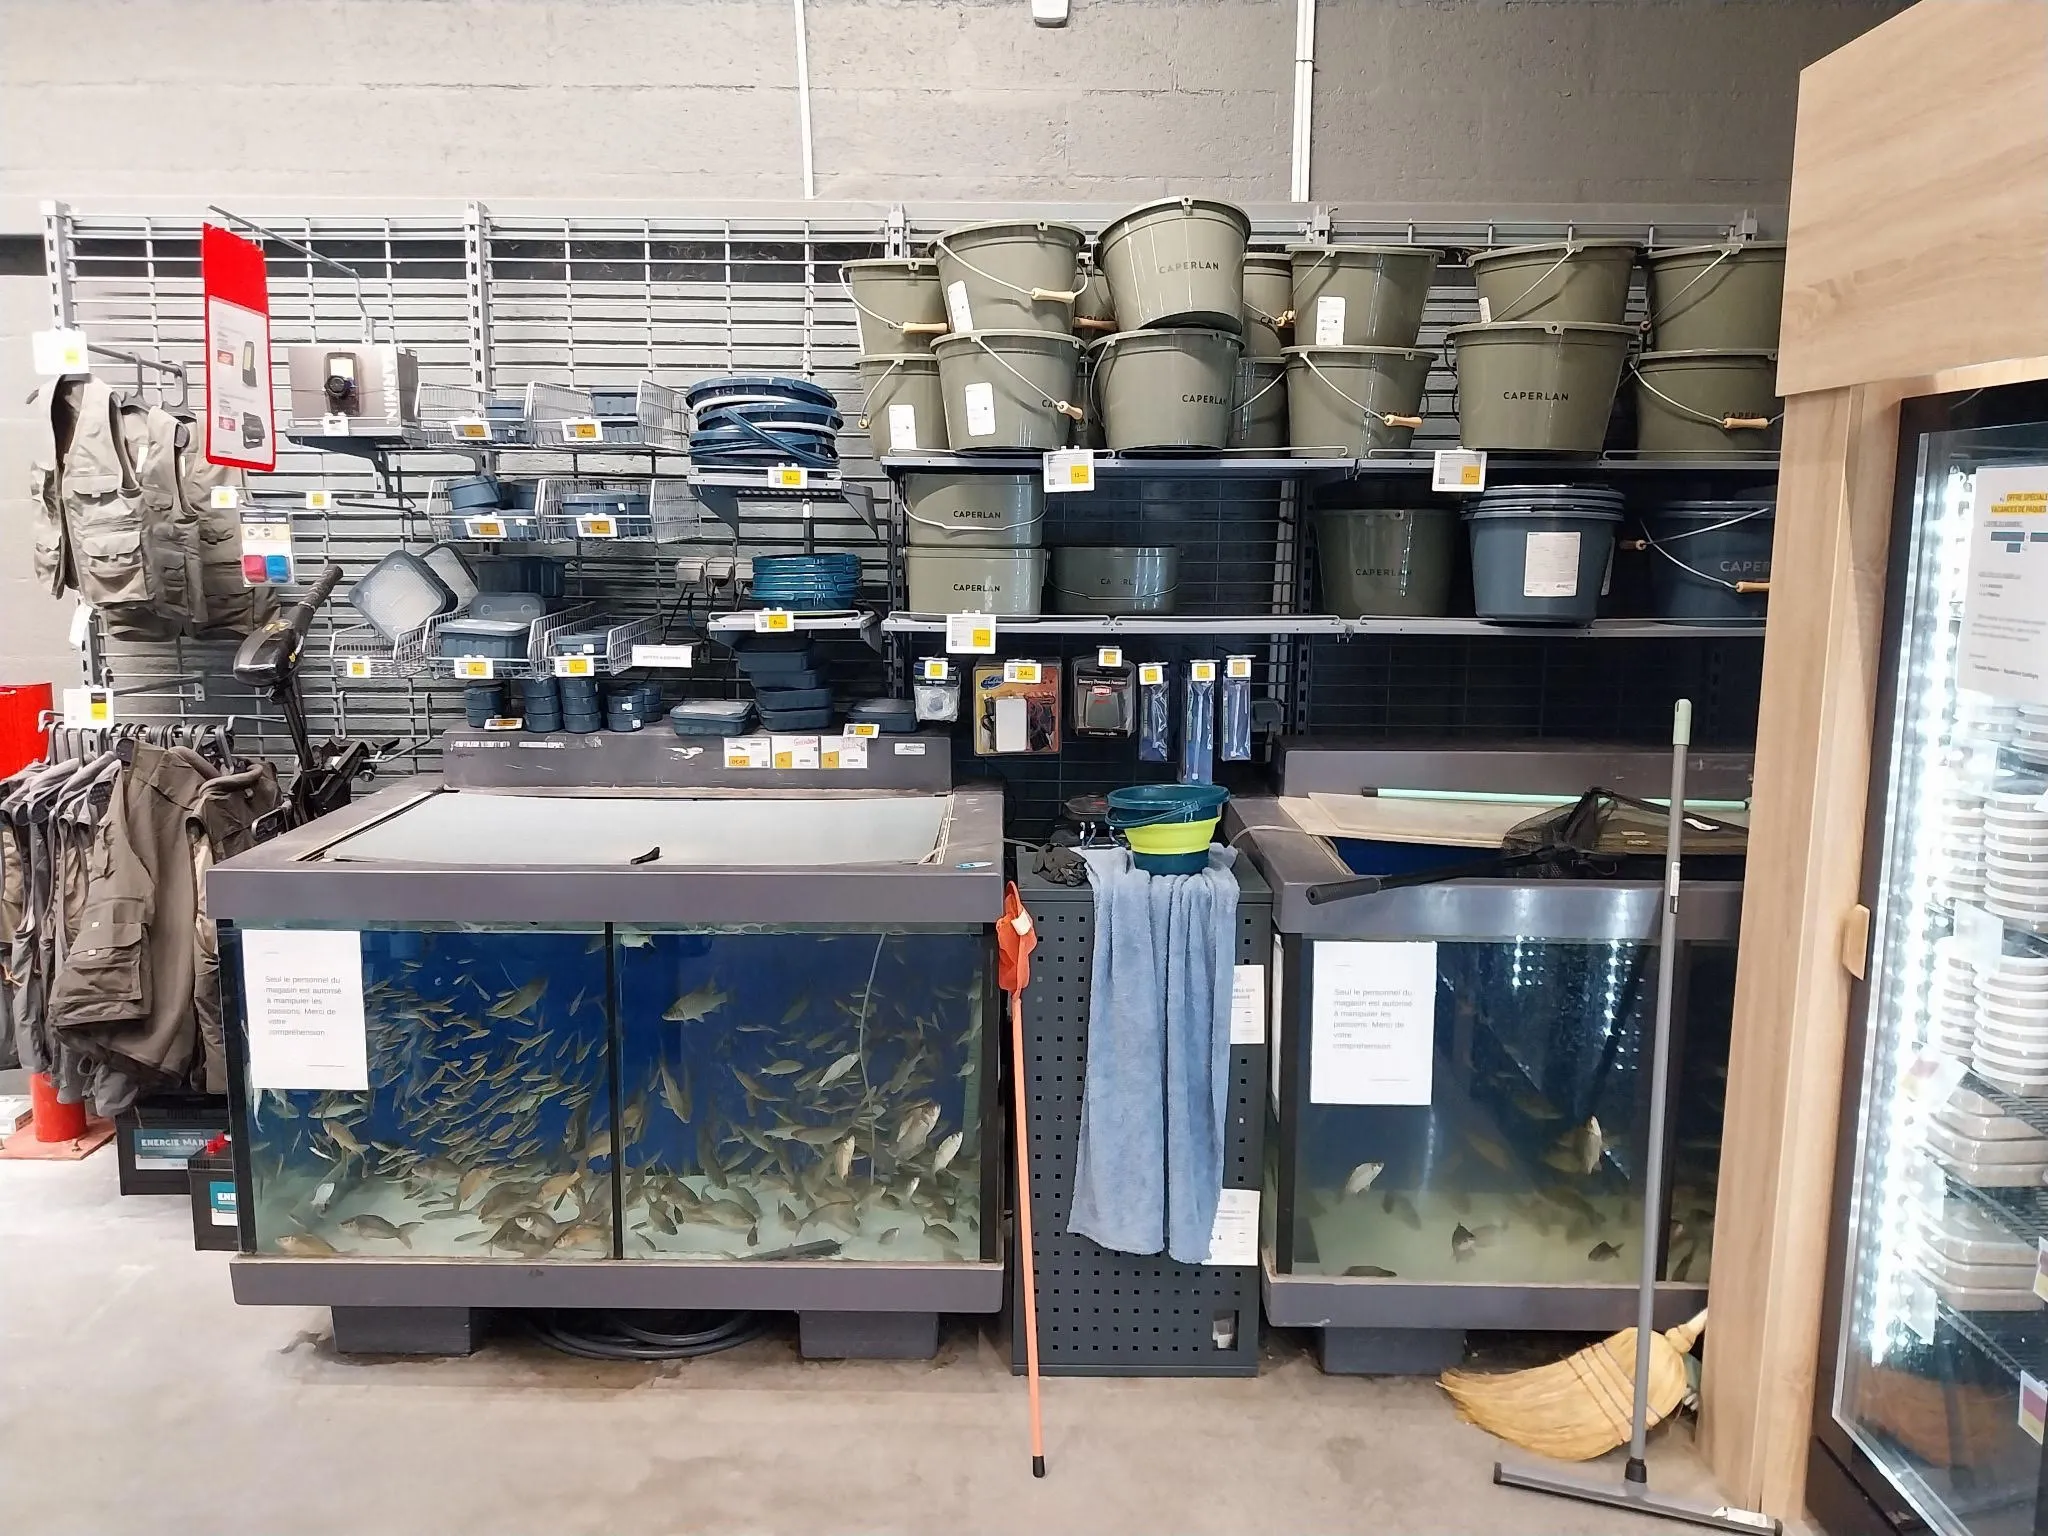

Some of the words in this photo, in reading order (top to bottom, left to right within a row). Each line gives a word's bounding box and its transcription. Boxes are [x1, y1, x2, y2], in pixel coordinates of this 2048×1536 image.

[1159, 261, 1219, 274] CAPERLAN
[1503, 391, 1569, 401] CAPERLAN
[953, 510, 1001, 519] CAPERLAN
[953, 583, 1001, 592] CAPERLAN
[265, 975, 282, 983] Seul
[292, 976, 329, 985] personnel
[331, 976, 341, 984] du
[265, 987, 297, 995] magasin
[1334, 988, 1352, 996] Seul
[1362, 989, 1401, 998] personnel
[311, 997, 322, 1005] les
[141, 1138, 180, 1147] ENERGIE
